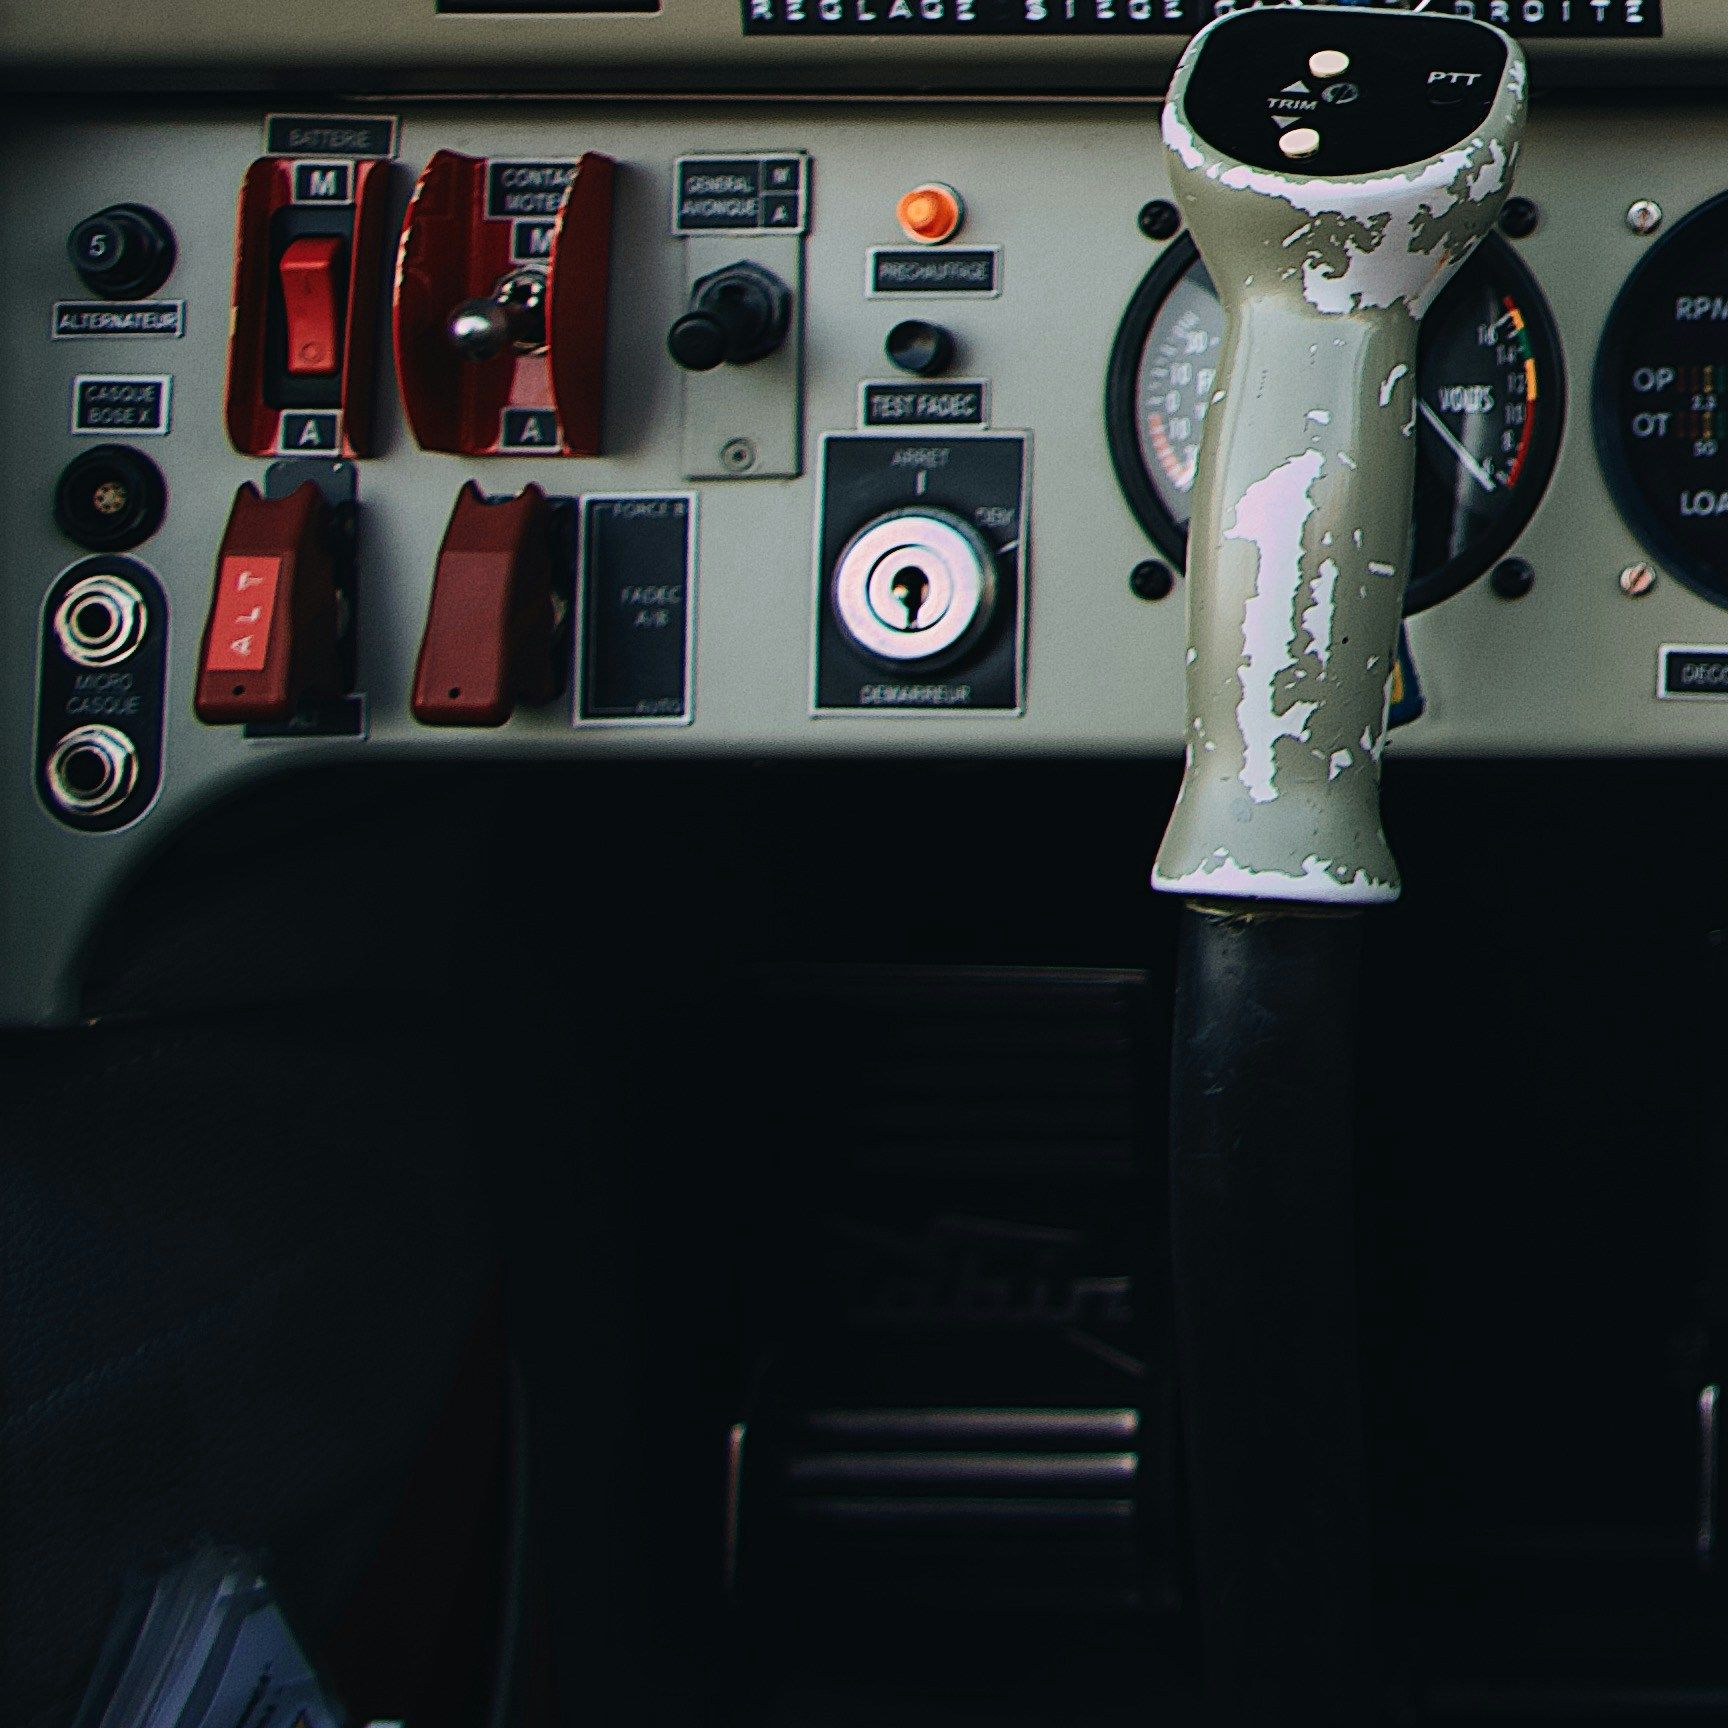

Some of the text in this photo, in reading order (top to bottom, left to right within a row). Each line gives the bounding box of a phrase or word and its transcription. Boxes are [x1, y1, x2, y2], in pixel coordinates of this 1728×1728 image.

[1428, 72, 1482, 86] PTT
[60, 311, 178, 330] ALTERNATEUR
[872, 396, 974, 415] TEST FADEC
